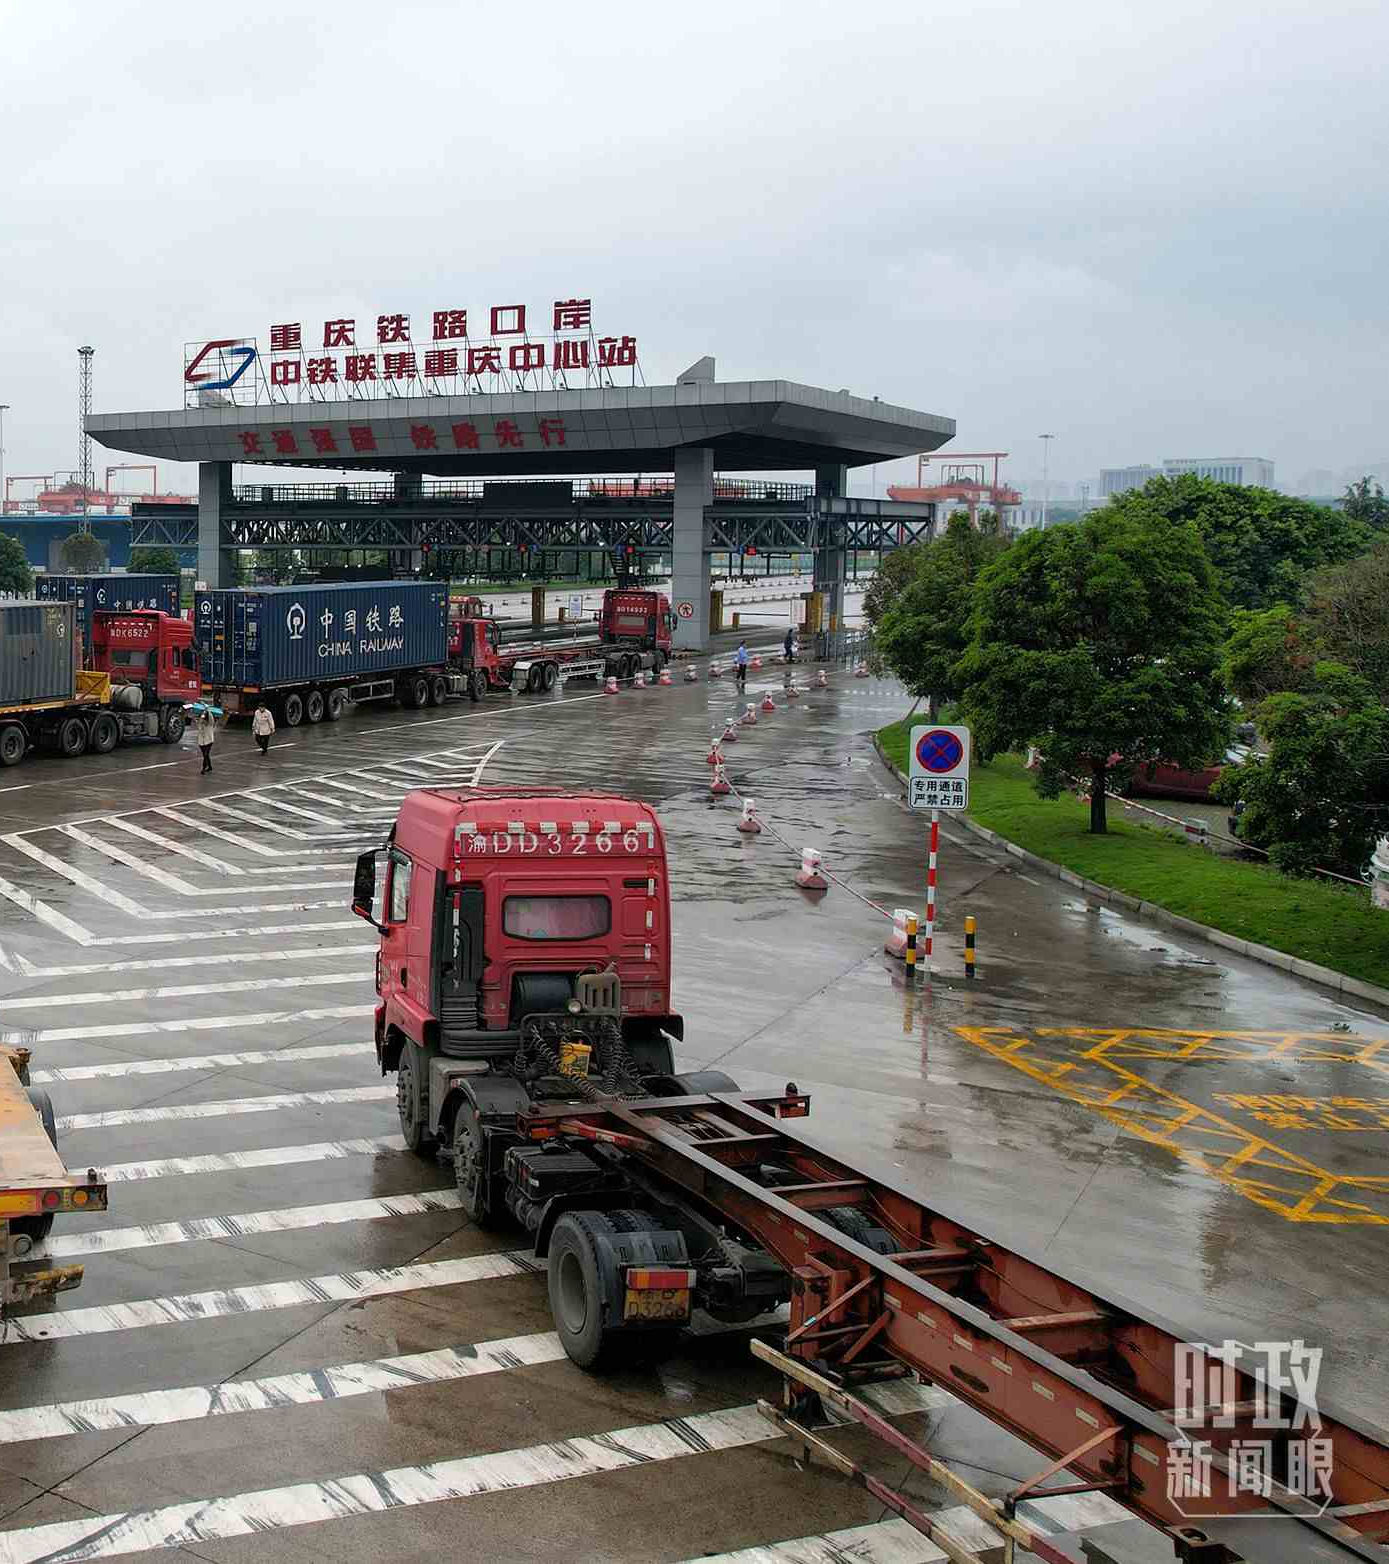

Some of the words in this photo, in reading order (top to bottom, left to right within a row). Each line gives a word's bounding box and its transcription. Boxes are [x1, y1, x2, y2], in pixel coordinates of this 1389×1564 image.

[270, 299, 591, 351] 重庆铁路口岸
[270, 336, 637, 385] 中铁联集重庆中心站
[410, 418, 567, 450] 铁路先行
[319, 604, 405, 639] 中国铁路
[317, 641, 353, 658] CHINA
[360, 637, 404, 654] RAILWAY
[914, 780, 964, 793] 专用通道
[914, 793, 964, 806] 严禁占用
[468, 829, 640, 855] 渝DD3266
